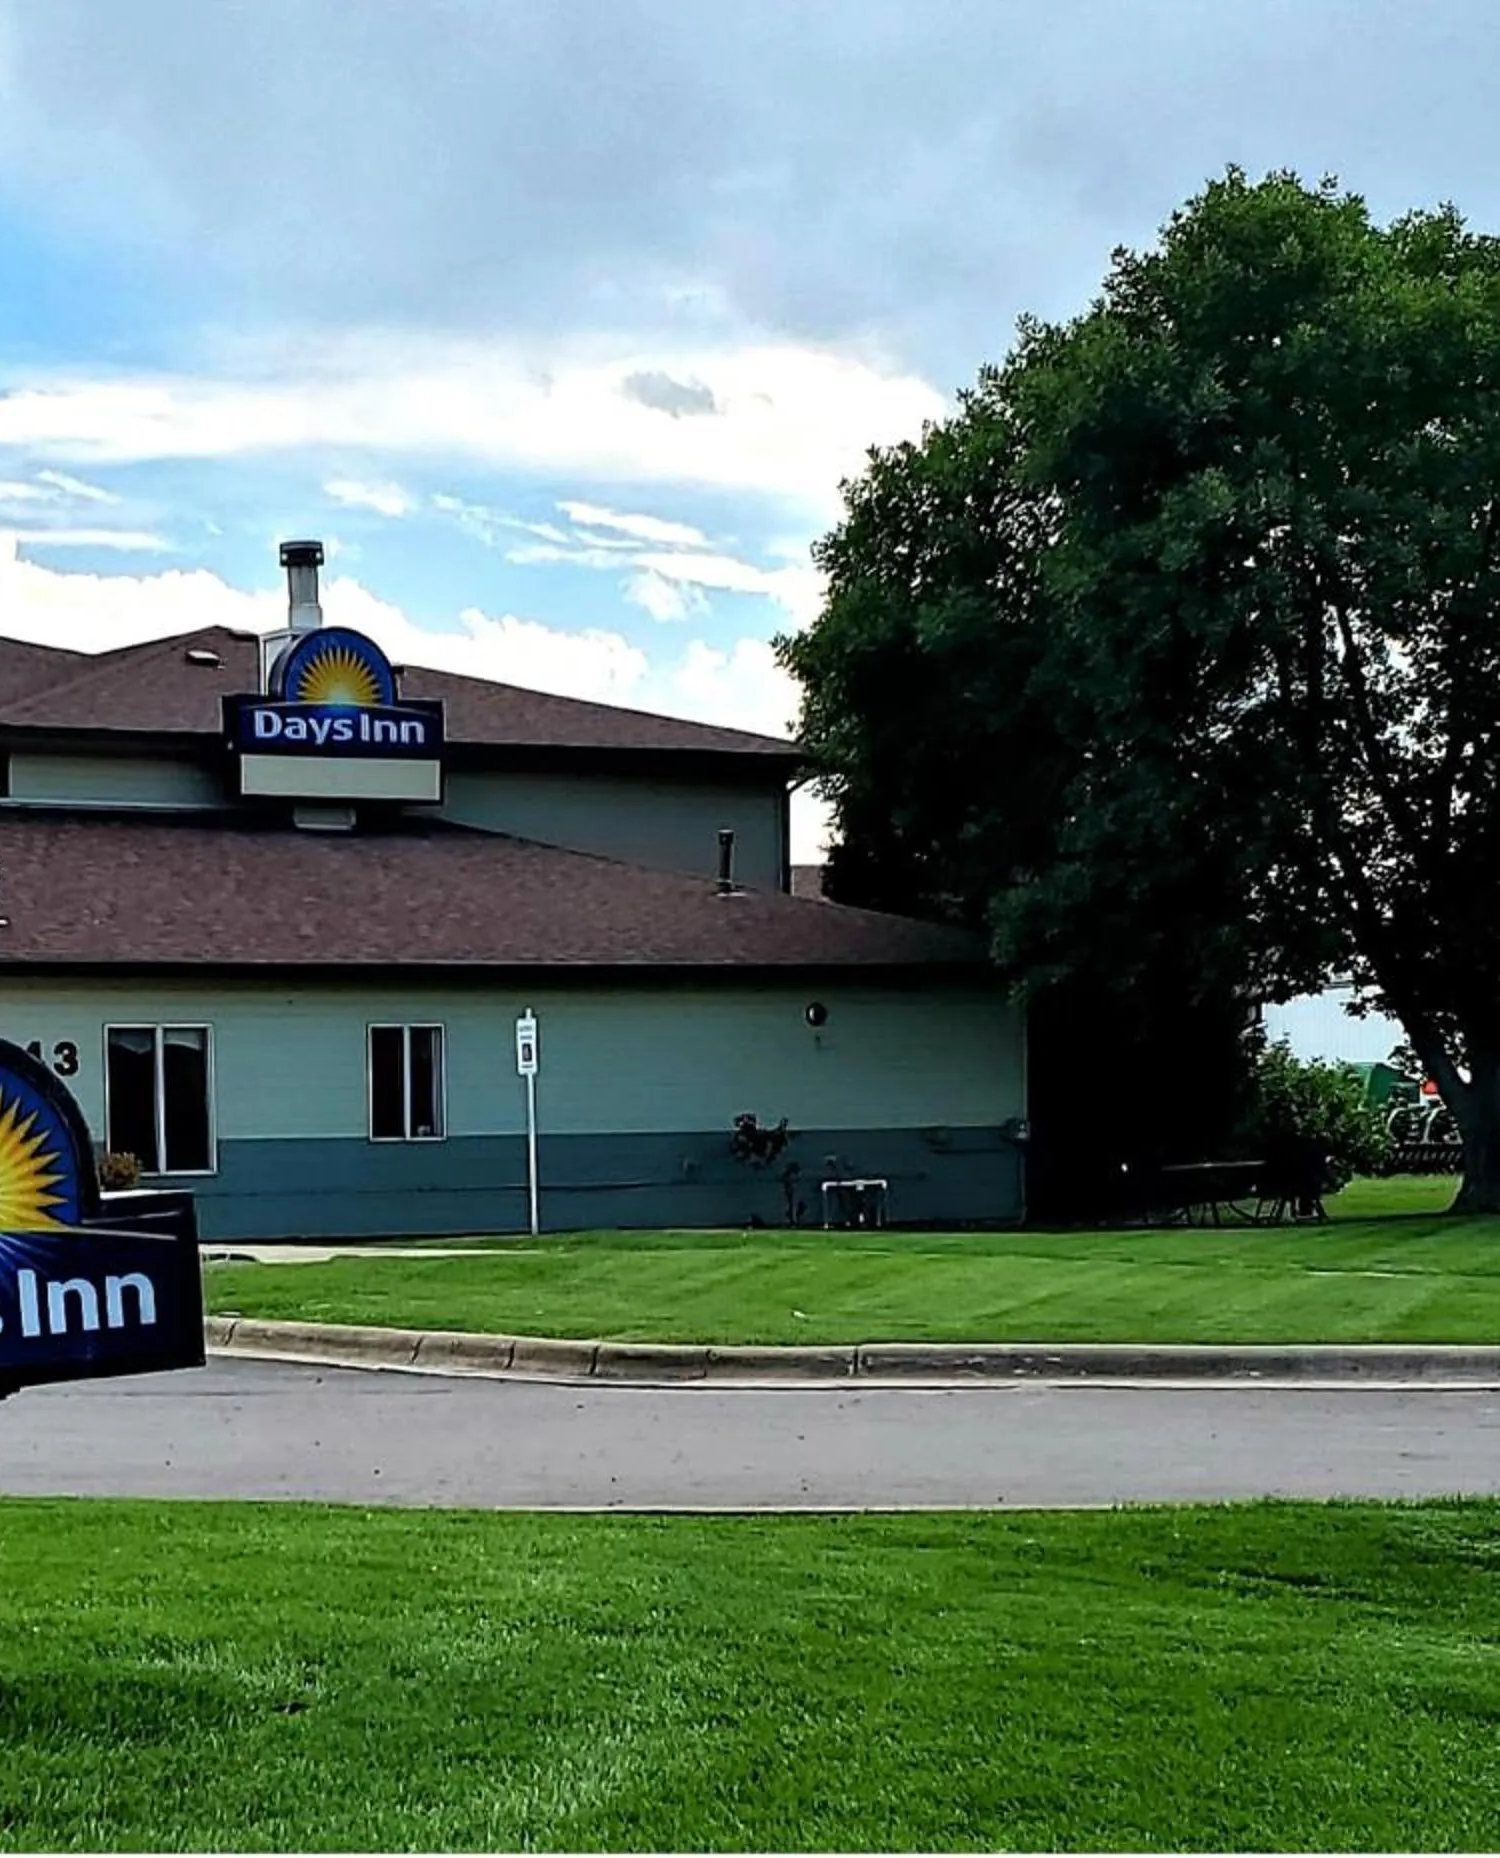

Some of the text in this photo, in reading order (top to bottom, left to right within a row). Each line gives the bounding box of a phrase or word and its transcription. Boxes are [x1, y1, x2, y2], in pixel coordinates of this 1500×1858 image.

[254, 710, 425, 744] Days Inn
[17, 1269, 156, 1338] Inn
